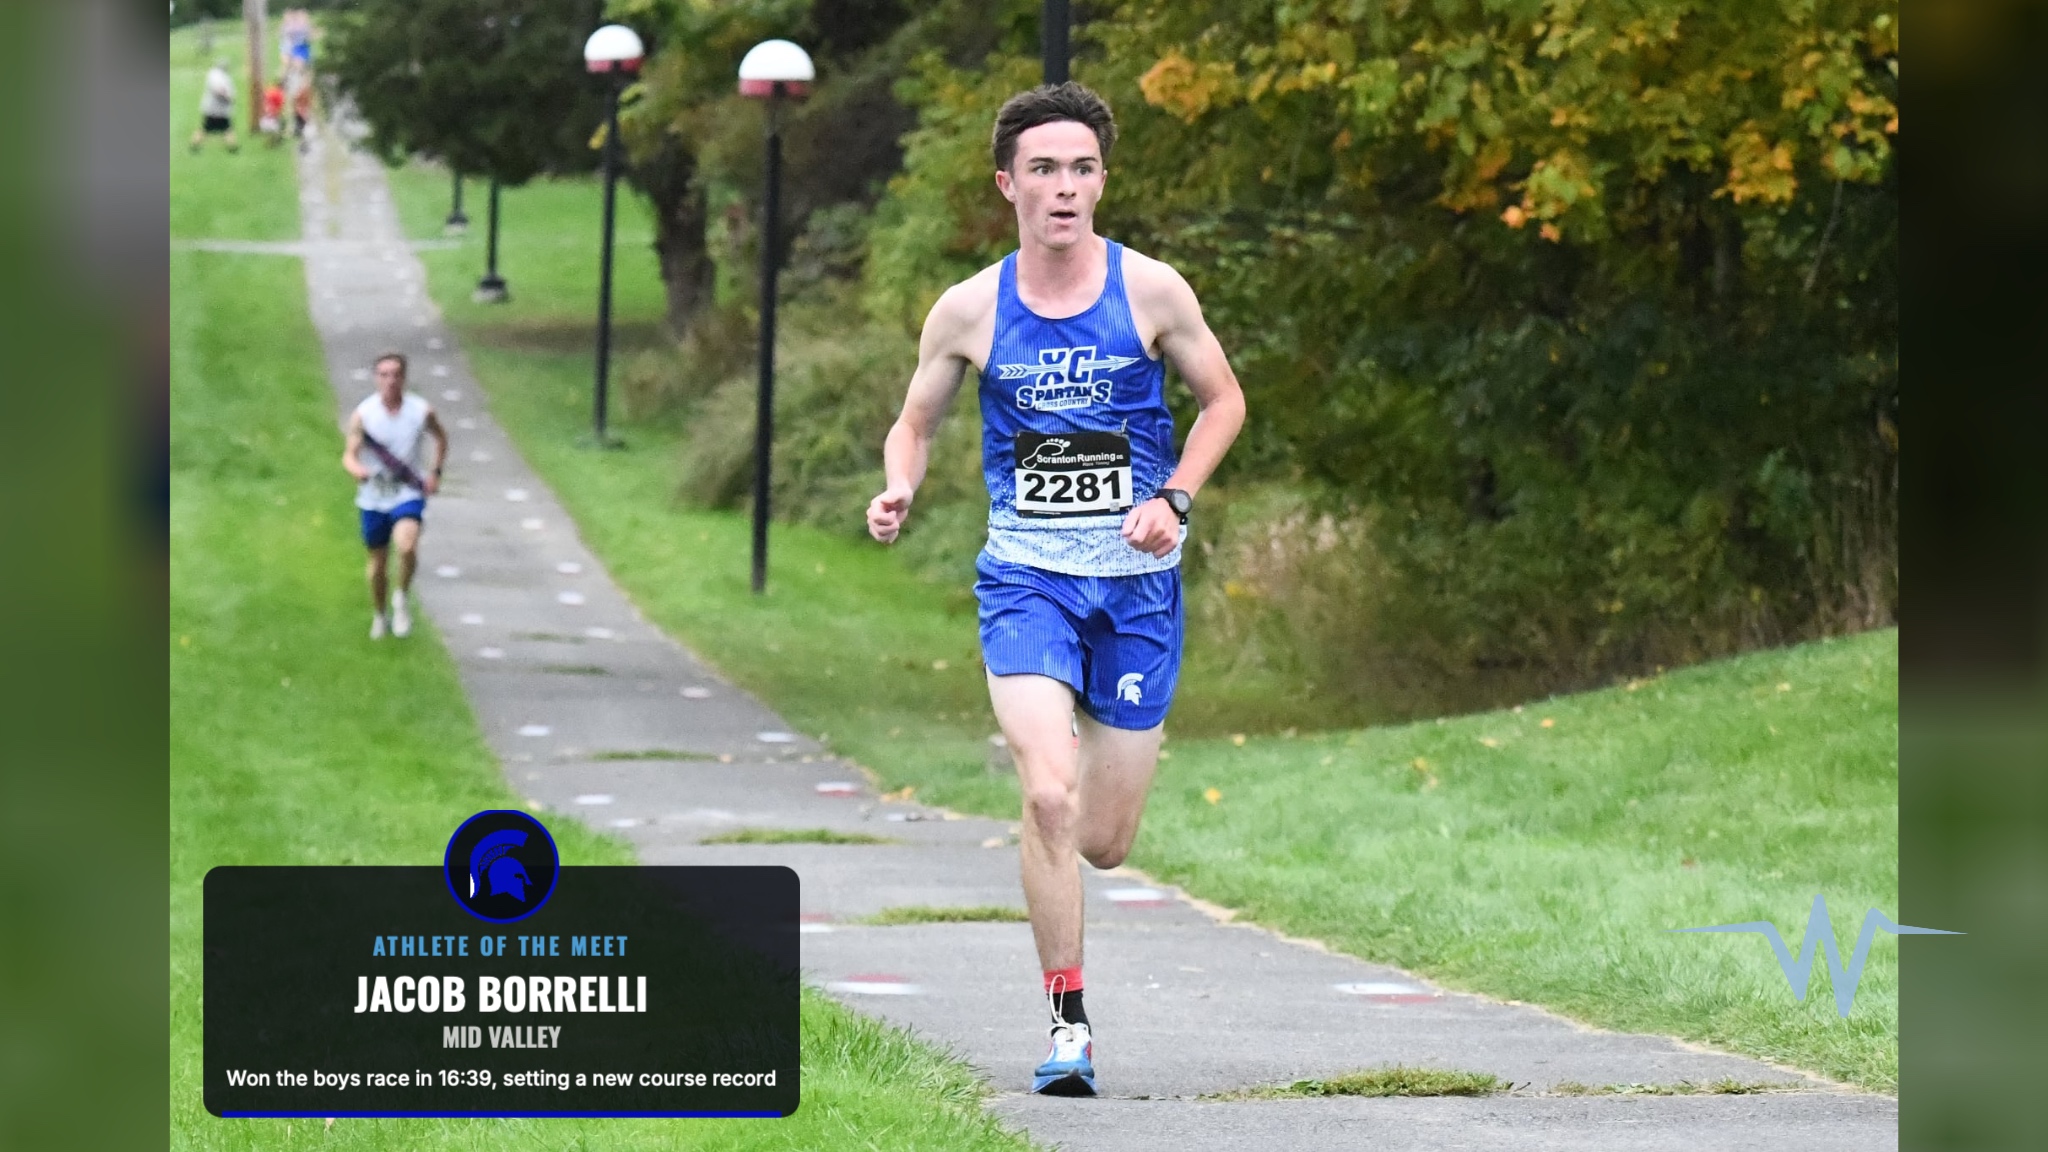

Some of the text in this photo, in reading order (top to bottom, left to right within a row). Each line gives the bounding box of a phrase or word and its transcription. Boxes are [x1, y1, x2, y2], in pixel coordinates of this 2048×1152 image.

[1039, 347, 1096, 386] XC
[1017, 381, 1112, 408] SPARTANS
[1059, 398, 1088, 407] COUNTRY
[1023, 470, 1121, 503] 2281
